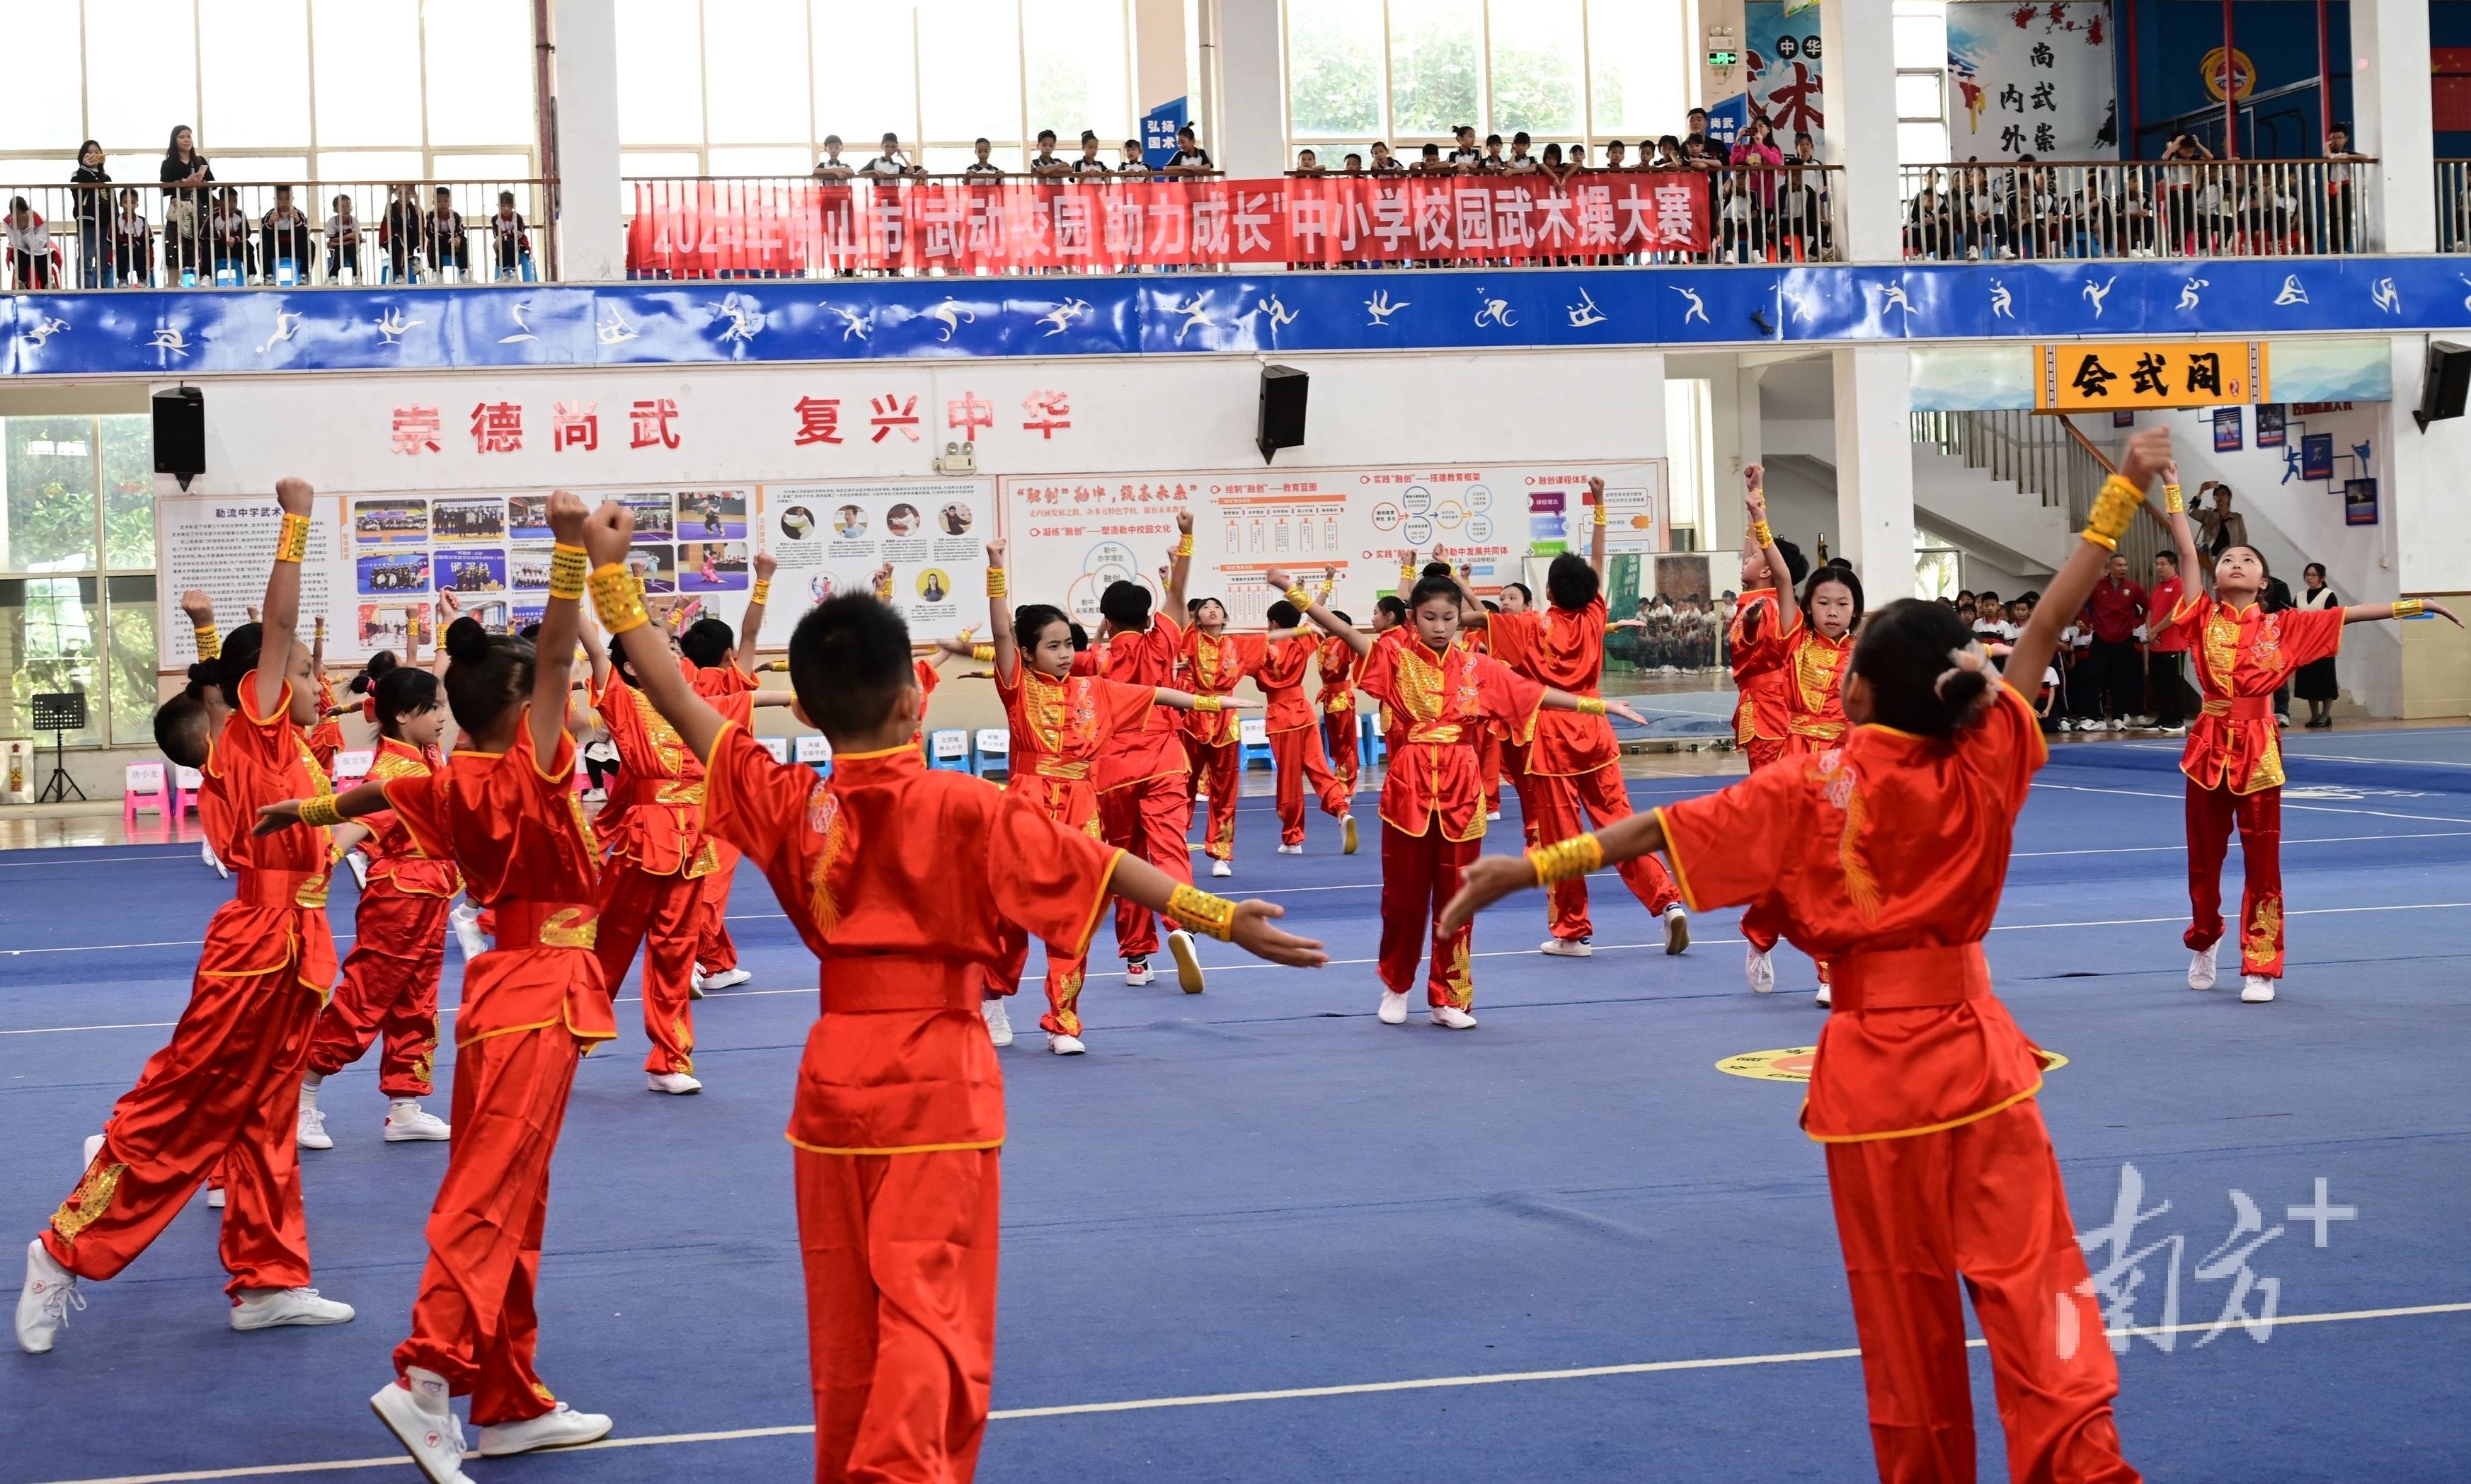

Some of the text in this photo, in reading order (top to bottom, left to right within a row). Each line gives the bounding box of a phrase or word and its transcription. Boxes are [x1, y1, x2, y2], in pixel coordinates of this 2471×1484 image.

[1779, 39, 1821, 55] 中华
[1147, 120, 1174, 133] 弘扬
[1710, 117, 1734, 129] 尚武
[1148, 137, 1176, 149] 国术
[2072, 352, 2222, 397] 会武阁
[392, 390, 1072, 454] 崇德尚武 复兴中华
[1538, 475, 1589, 485] 融创课程体系
[1098, 554, 1124, 563] 办学理念
